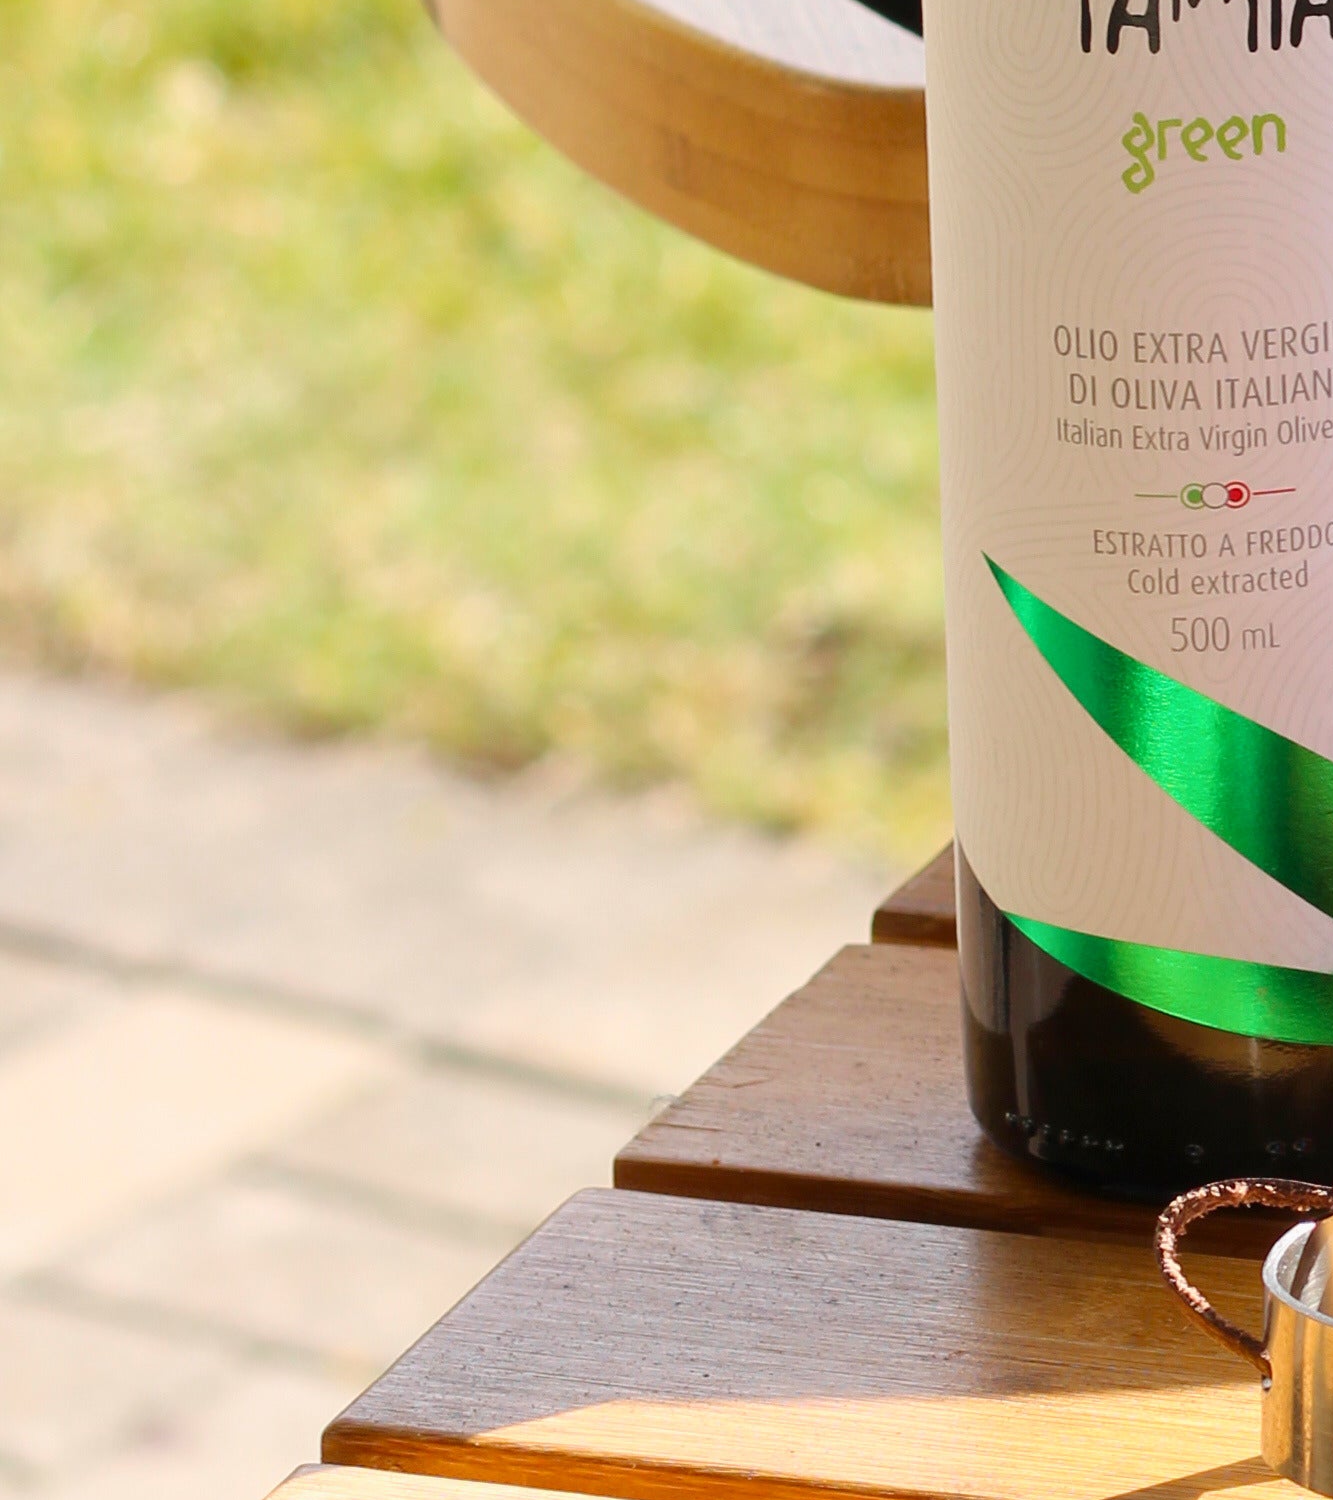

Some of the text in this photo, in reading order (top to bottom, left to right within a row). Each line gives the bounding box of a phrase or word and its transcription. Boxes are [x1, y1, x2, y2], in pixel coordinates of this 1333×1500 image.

[1120, 110, 1287, 195] green
[1053, 324, 1119, 362] OLIO
[1133, 332, 1229, 365] EXTRA
[1069, 372, 1098, 407] DI
[1111, 376, 1202, 411] OLIVA
[1056, 417, 1123, 449] Italian
[1132, 425, 1190, 451] Extra
[1198, 423, 1267, 457] Virgin
[1276, 416, 1333, 446] Olive
[1093, 528, 1208, 559] ESTRATTO
[1218, 533, 1237, 557] A
[1127, 559, 1309, 596] Cold extracted
[1170, 615, 1280, 653] 500 mL
